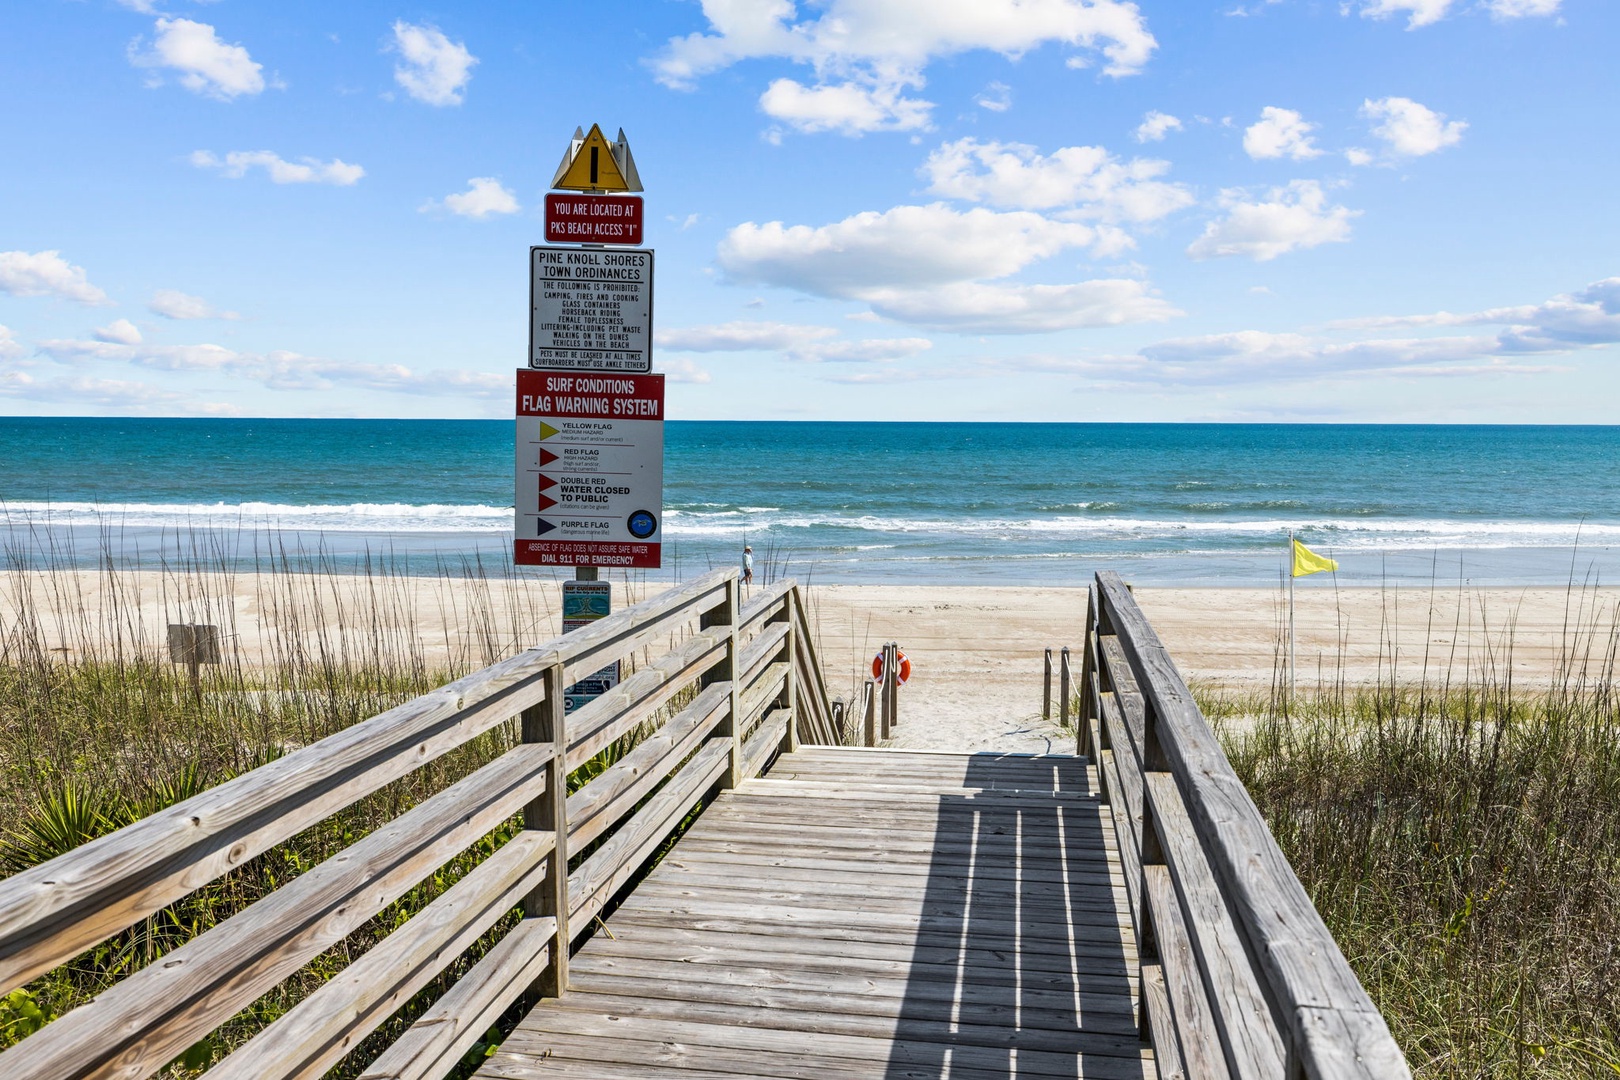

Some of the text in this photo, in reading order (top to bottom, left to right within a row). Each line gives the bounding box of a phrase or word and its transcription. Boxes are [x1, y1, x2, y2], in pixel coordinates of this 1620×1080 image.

[555, 203, 634, 216] YOU ARE LOCATED AT
[551, 222, 565, 233] PKS
[568, 223, 592, 234] BEACH
[595, 224, 622, 235] ACCESS
[540, 253, 644, 266] PINE KNOLL SHORES
[544, 266, 640, 279] TOWN ORDINANCES
[603, 284, 640, 292] PROHIBITED:
[541, 324, 605, 332] LITTERING-INCLUDING
[547, 377, 634, 394] SURF CONDITIONS
[523, 395, 658, 416] FLAG WARNING SYSTEM
[528, 543, 549, 551] ABSENCE
[542, 554, 634, 564] DIAL 911 FOR EMERGENCY
